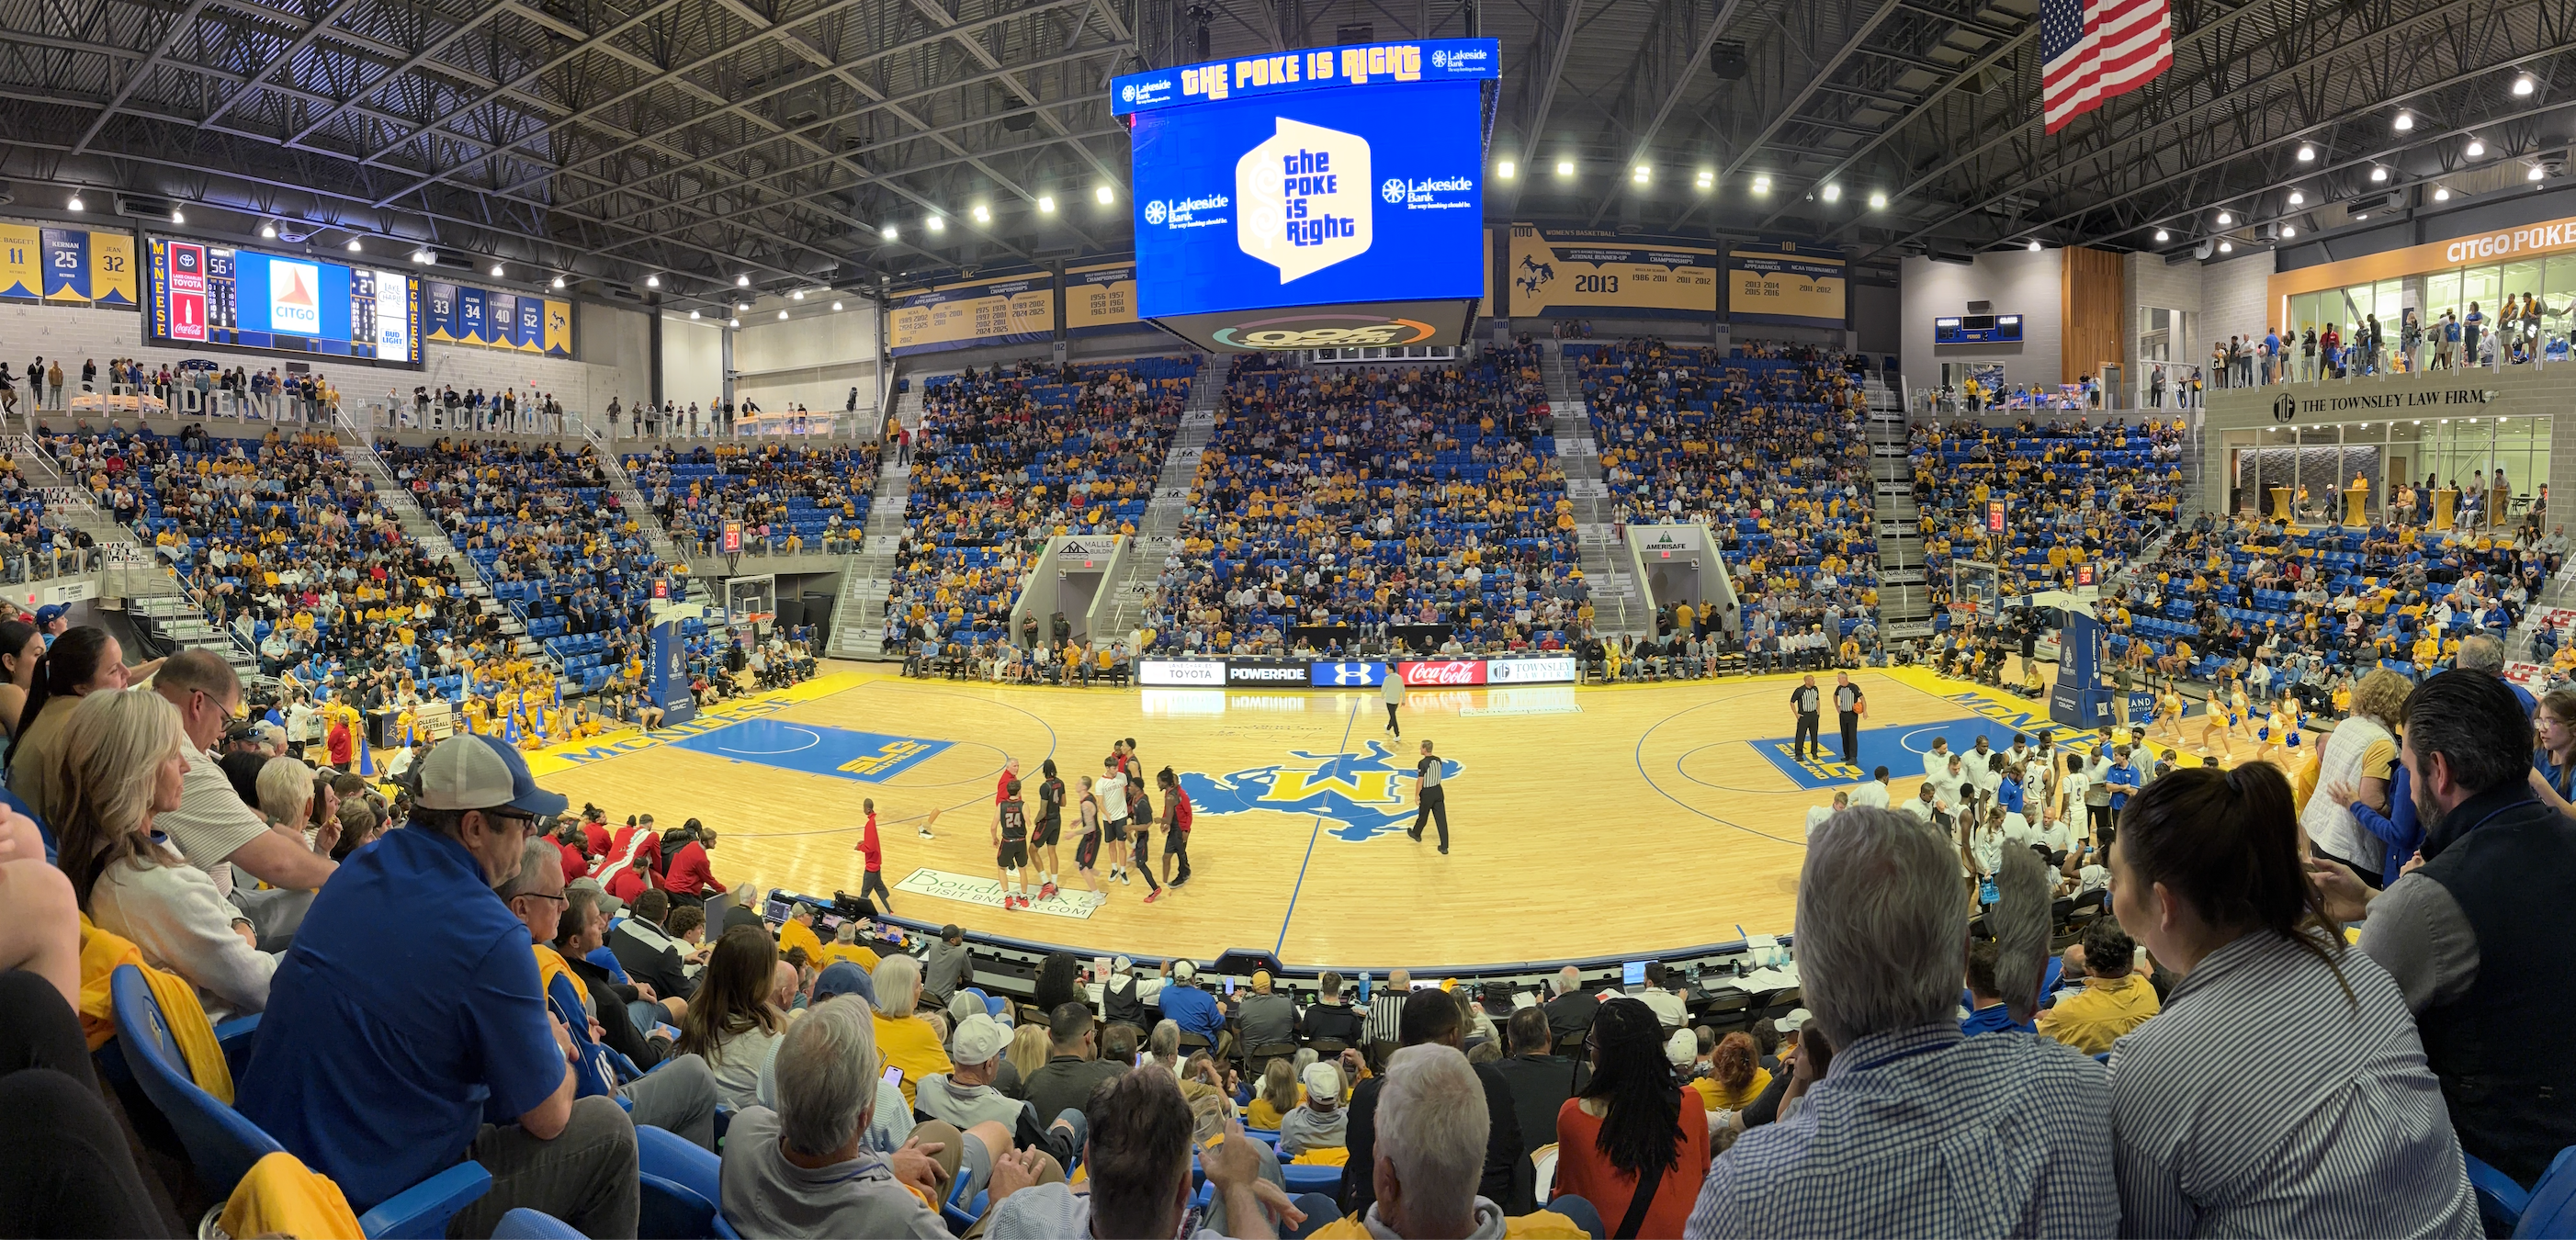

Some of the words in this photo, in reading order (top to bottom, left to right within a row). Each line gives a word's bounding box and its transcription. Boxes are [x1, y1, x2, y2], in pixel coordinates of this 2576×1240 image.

[1447, 49, 1486, 60] Lakeside
[1236, 55, 1299, 89] POKE
[1307, 51, 1333, 80] IS
[1341, 45, 1421, 84] RIGHT
[1136, 79, 1171, 92] Lakeside
[1136, 92, 1150, 101] Bank
[1283, 149, 1329, 175] the
[1284, 175, 1337, 197] POKE
[1407, 176, 1472, 192] Lakeside
[1169, 194, 1228, 212] Lakeside
[1407, 192, 1434, 203] Bank
[1168, 211, 1192, 223] Bank
[1287, 214, 1354, 246] Right
[1514, 227, 1532, 237] 100
[4, 237, 34, 245] BAGGETT
[52, 241, 79, 249] KERNAN
[1782, 241, 1796, 251] 101
[2447, 234, 2510, 262] CITGO
[9, 248, 24, 264] 11
[55, 251, 78, 268] 25
[103, 256, 124, 272] 32
[211, 259, 226, 274] 56
[173, 279, 202, 288] TOYOTA
[1087, 274, 1129, 282] CHAMPIONSHIPS
[1575, 275, 1618, 293] 2013
[360, 279, 374, 294] 27
[990, 286, 1027, 294] CHAMPIONSHIPS
[915, 296, 946, 305] APPEARANCES
[276, 306, 314, 320] CITGO
[433, 300, 449, 315] 33
[465, 305, 481, 319] 34
[495, 310, 510, 323] 40
[524, 314, 537, 328] 52
[175, 323, 202, 335] Coca-Cola
[1054, 343, 1065, 351] 112
[75, 380, 299, 421] STUDENT
[2302, 400, 2326, 412] THE
[2330, 393, 2403, 411] TOWNSLEY
[2408, 391, 2440, 406] LAW
[2445, 389, 2483, 404] FIRM
[1991, 513, 2002, 530] 30
[727, 533, 738, 548] 30
[2080, 574, 2091, 583] 30
[656, 588, 665, 596] 30
[1169, 669, 1212, 678] TOYOTA
[1408, 662, 1477, 684] Coca-Cola
[1515, 662, 1572, 672] TOWNSLEY
[668, 698, 689, 706] NAVARRE
[2055, 695, 2076, 705] NAVARRE
[2058, 702, 2074, 711] GMC
[2100, 705, 2106, 713] K
[836, 739, 919, 774] SLC
[864, 744, 932, 775] SOUTHLAND
[2028, 776, 2035, 789] 2
[1053, 789, 1059, 803] 4
[1005, 813, 1022, 827] 24
[926, 886, 968, 898] VISIT
